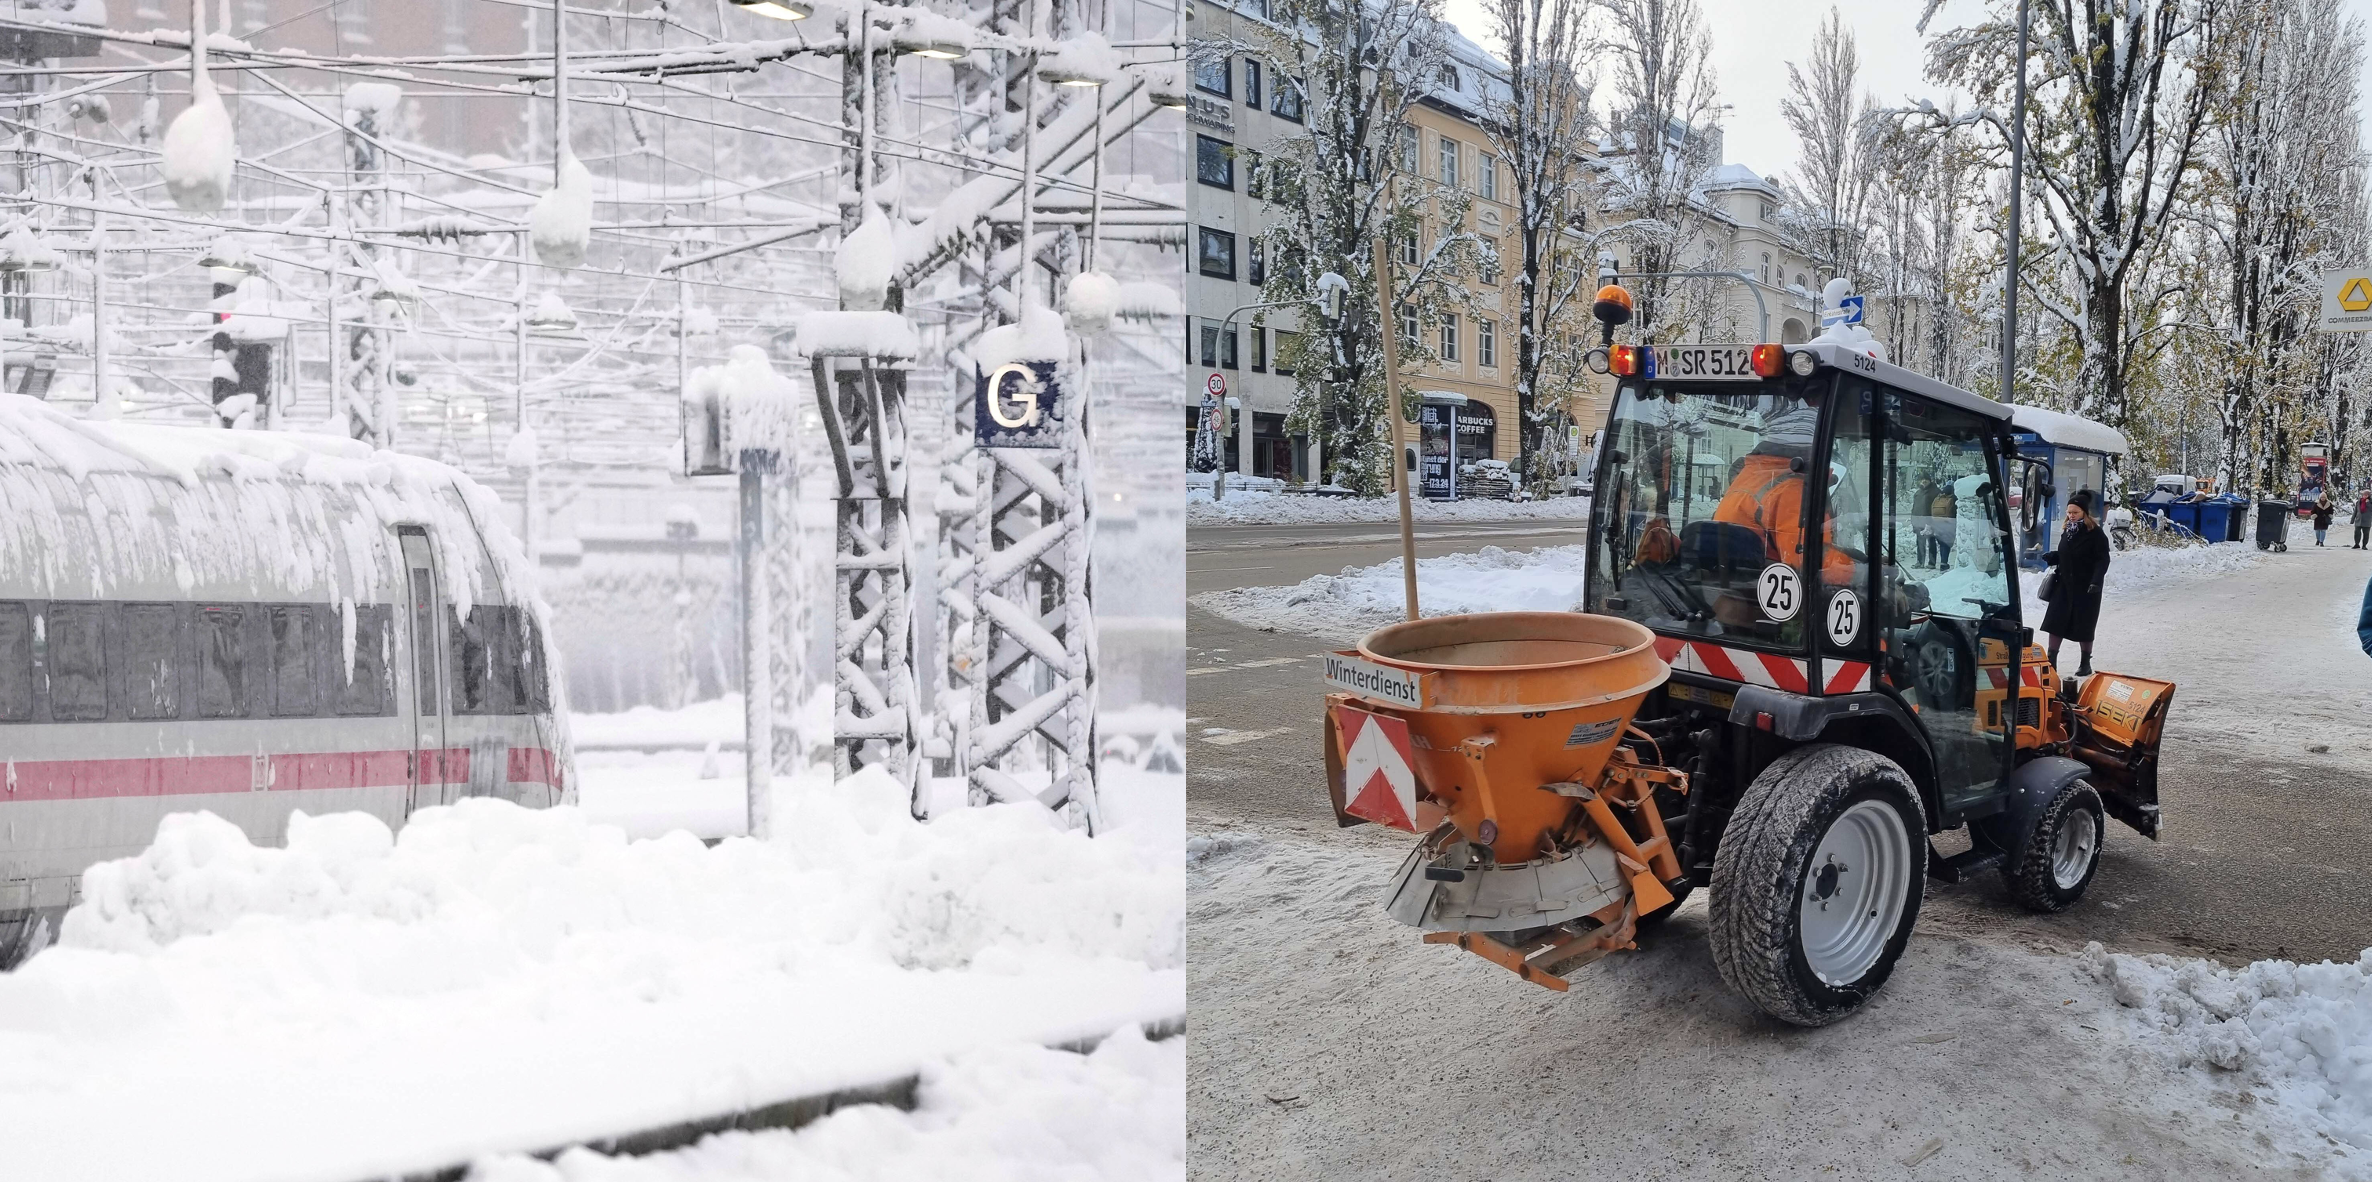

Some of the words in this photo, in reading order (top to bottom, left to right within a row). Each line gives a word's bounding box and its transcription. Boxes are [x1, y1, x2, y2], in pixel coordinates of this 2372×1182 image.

[1656, 350, 1669, 375] M
[1681, 349, 1707, 375] SR
[1710, 349, 1755, 375] 512
[1854, 353, 1876, 373] 5124
[987, 363, 1038, 428] G
[1211, 379, 1222, 390] 30
[1766, 573, 1793, 611] 25
[1834, 600, 1854, 635] 25
[1326, 657, 1416, 702] Winterdienst
[2095, 700, 2142, 734] ISEKI
[2128, 701, 2147, 715] 5124
